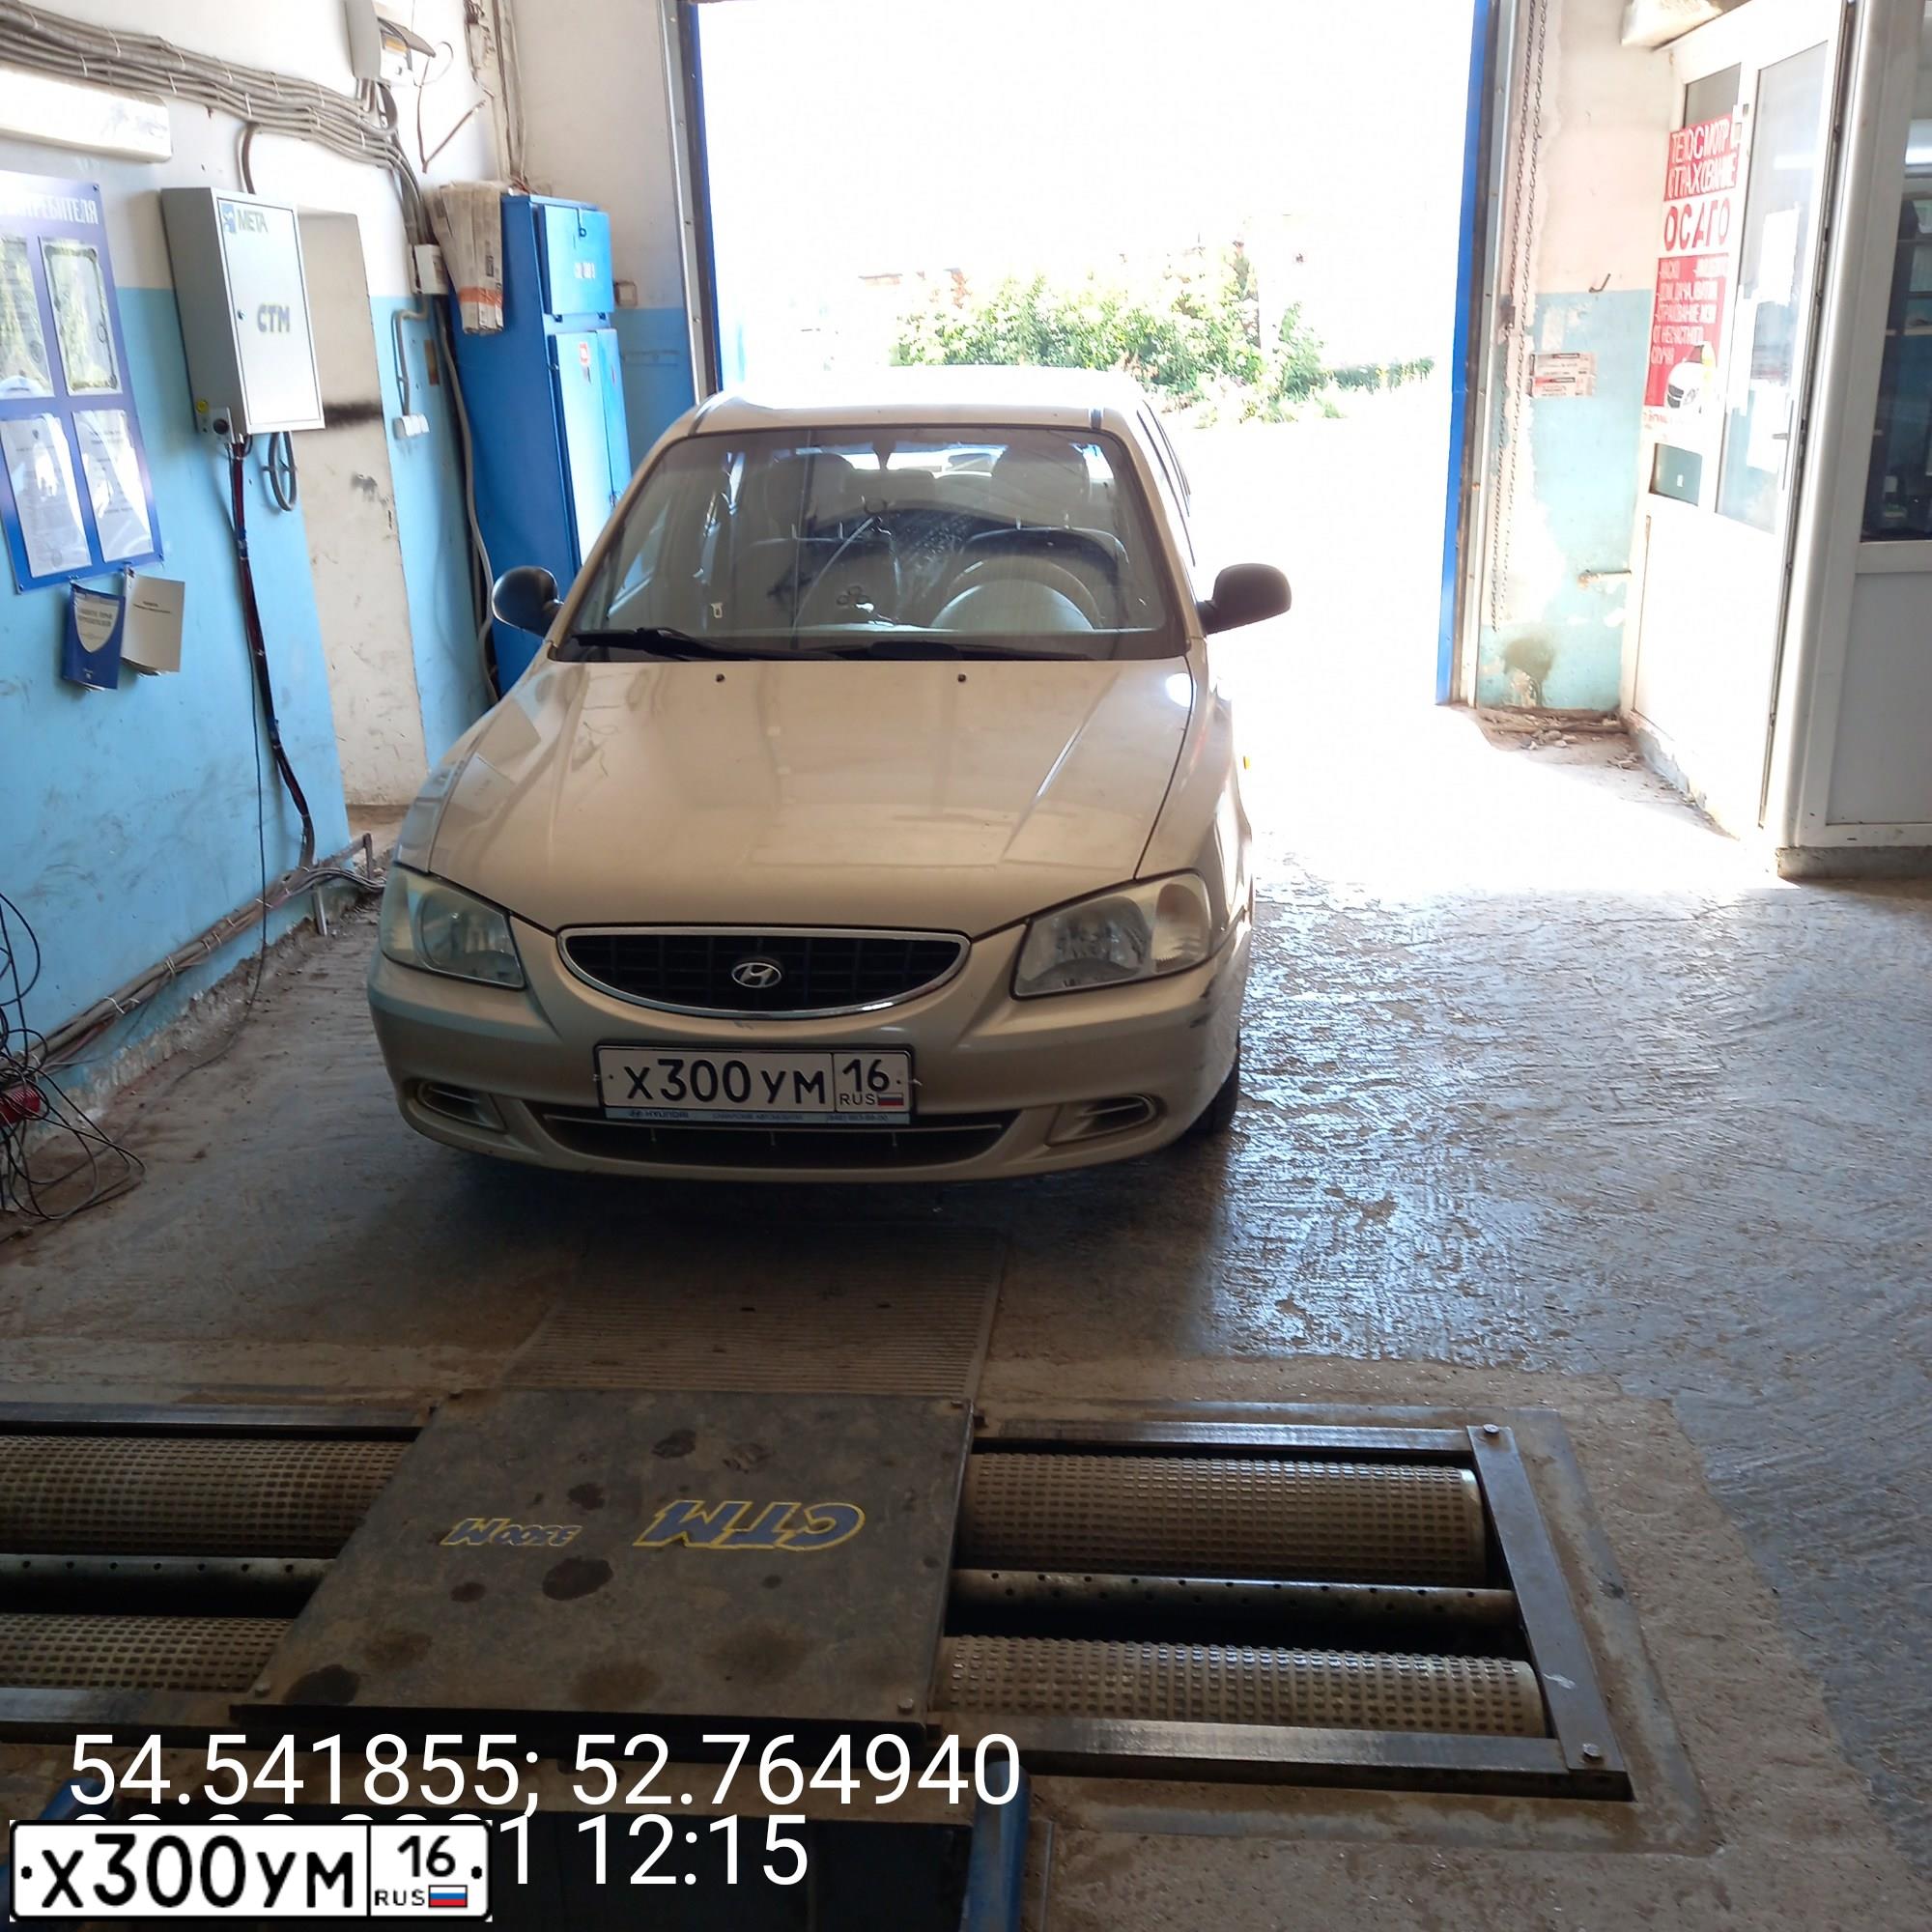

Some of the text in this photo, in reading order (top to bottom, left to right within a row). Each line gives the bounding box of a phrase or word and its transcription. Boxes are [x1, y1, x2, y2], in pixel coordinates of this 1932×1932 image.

[1663, 197, 1731, 251] ОСАГО
[256, 303, 291, 333] СТМ
[842, 1059, 890, 1093] 16
[839, 1093, 875, 1106] RUS
